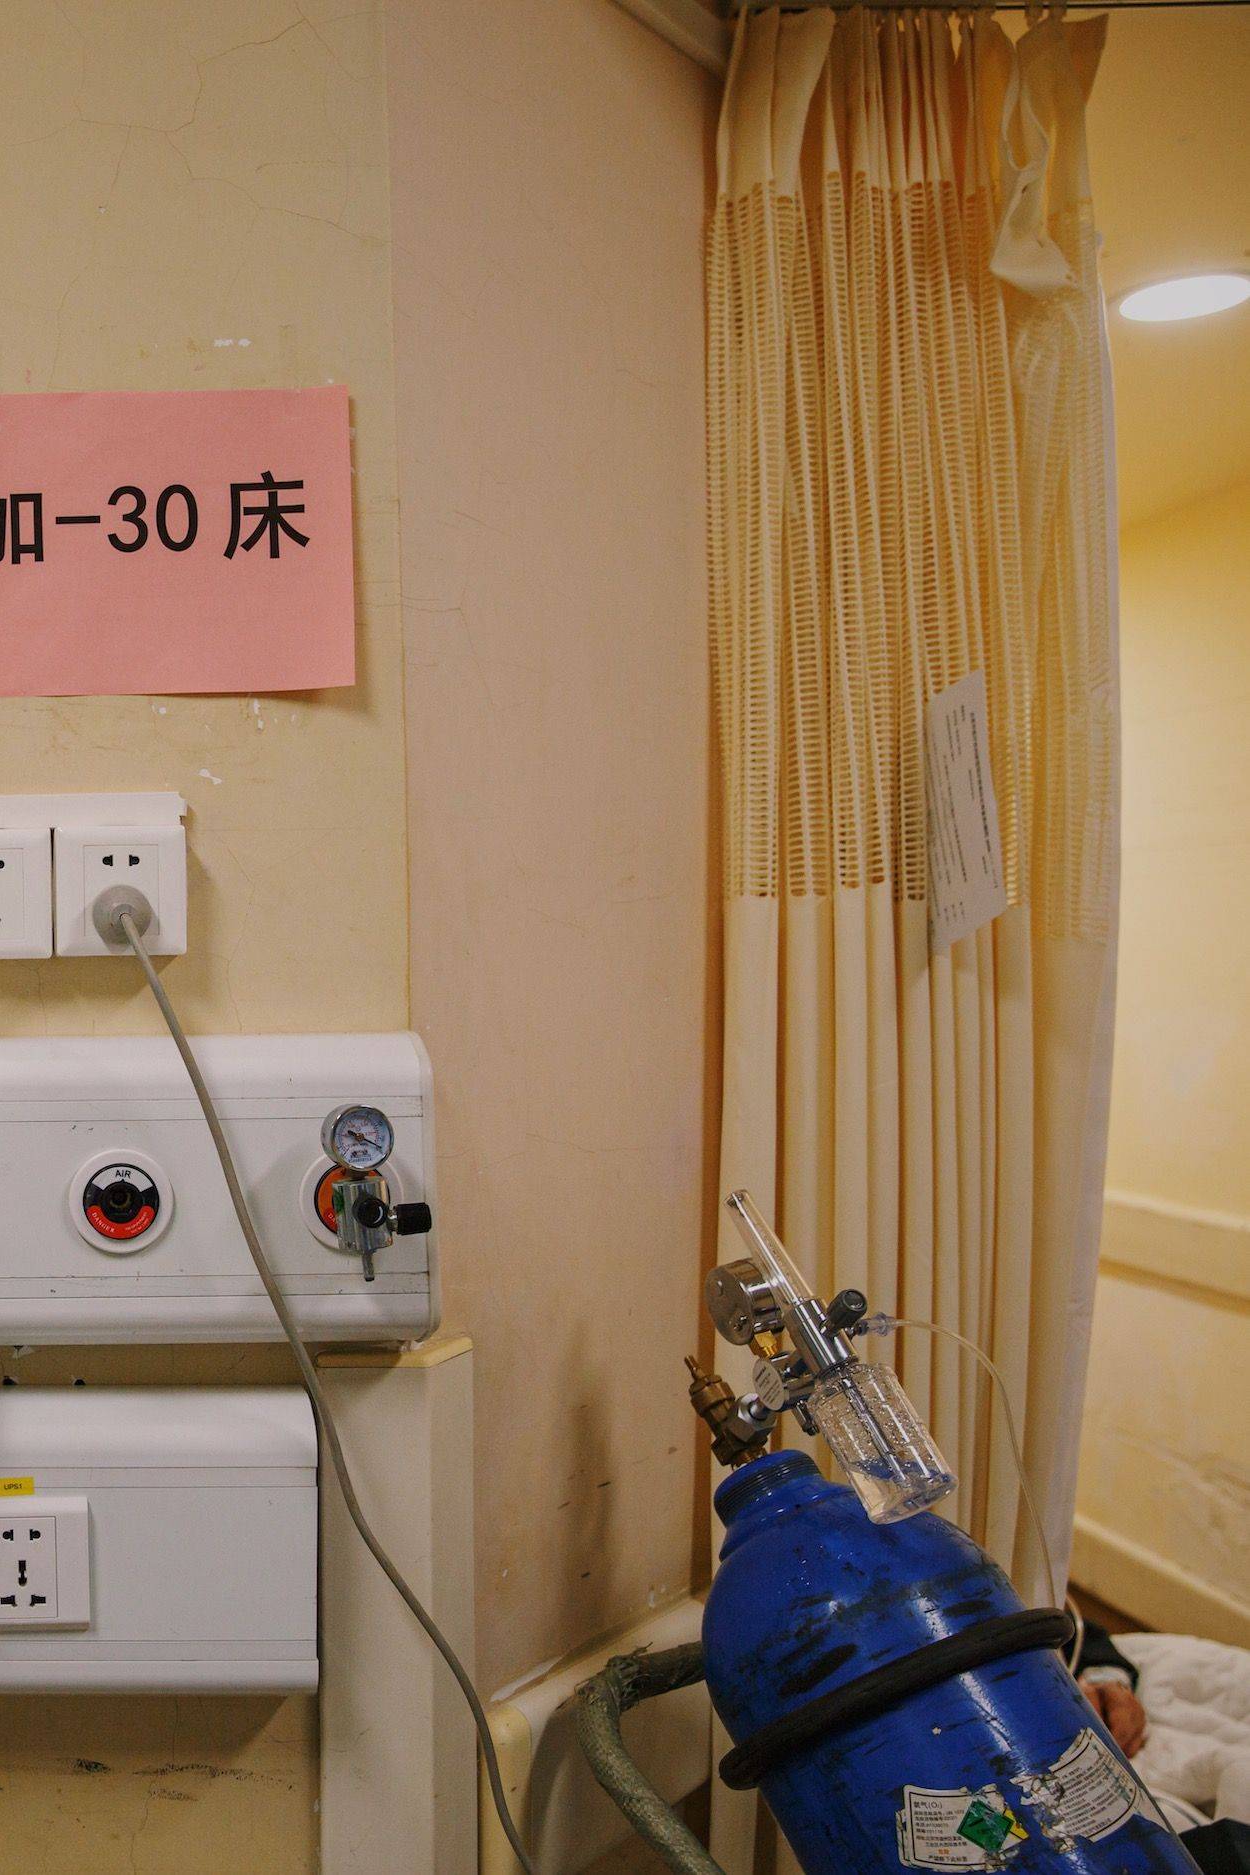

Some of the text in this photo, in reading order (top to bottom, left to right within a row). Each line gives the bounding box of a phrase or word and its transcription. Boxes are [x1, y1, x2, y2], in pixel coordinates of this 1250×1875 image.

[114, 1169, 132, 1179] AIR
[91, 1212, 115, 1233] DANGER
[3, 1482, 23, 1491] UPS1
